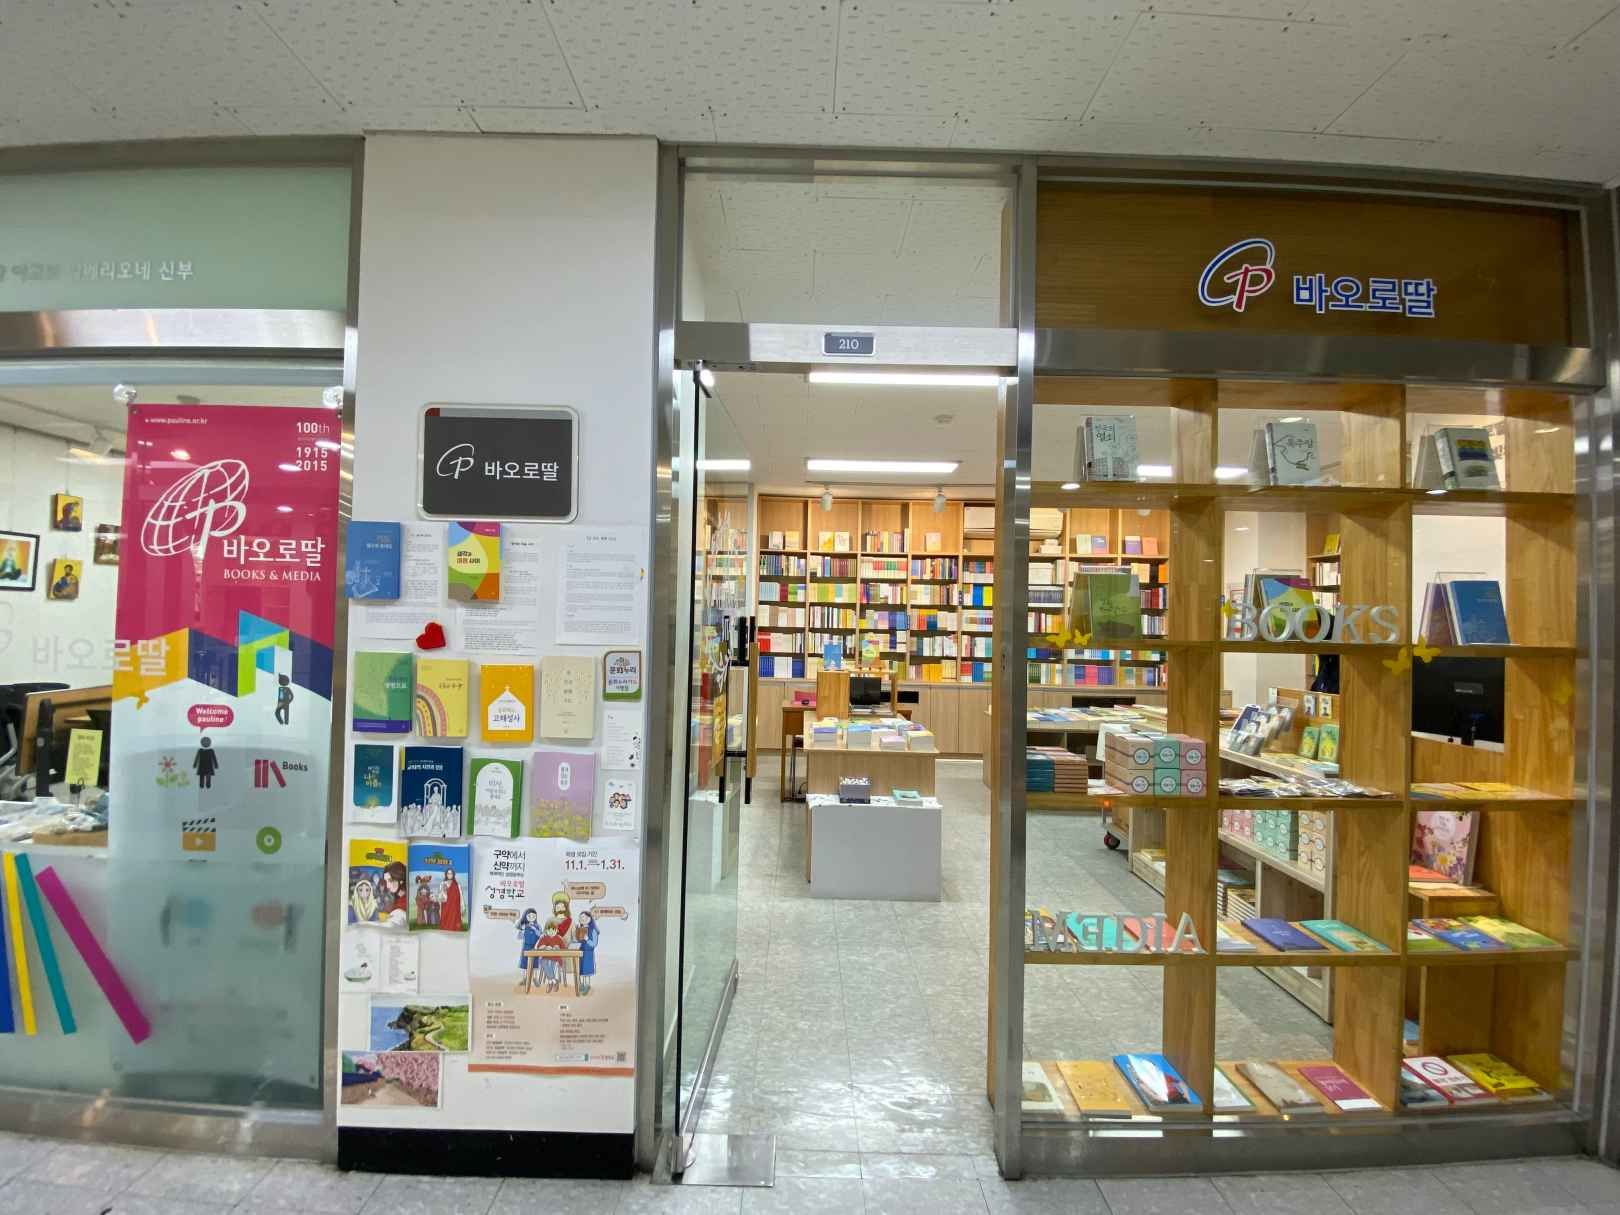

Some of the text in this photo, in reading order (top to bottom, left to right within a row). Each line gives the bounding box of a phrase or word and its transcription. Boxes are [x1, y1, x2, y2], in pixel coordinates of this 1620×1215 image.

[159, 260, 193, 281] 신부
[1294, 274, 1437, 317] 바오로딸
[839, 338, 859, 350] 210
[296, 422, 330, 434] 100th
[296, 447, 328, 459] 1915
[296, 460, 328, 472] 2015
[484, 461, 560, 482] 바오로딸
[222, 536, 326, 566] 바오로딸
[224, 569, 321, 582] BOOKS & MEDIA
[1228, 603, 1398, 643] BOOKS
[33, 636, 168, 677] 바오로딸
[194, 706, 229, 715] Welcome
[281, 760, 307, 771] Books
[493, 849, 525, 860] 구약에서
[492, 861, 525, 873] 신약까지
[484, 886, 526, 899] 성경학교
[1026, 911, 1206, 953] MEDIA
